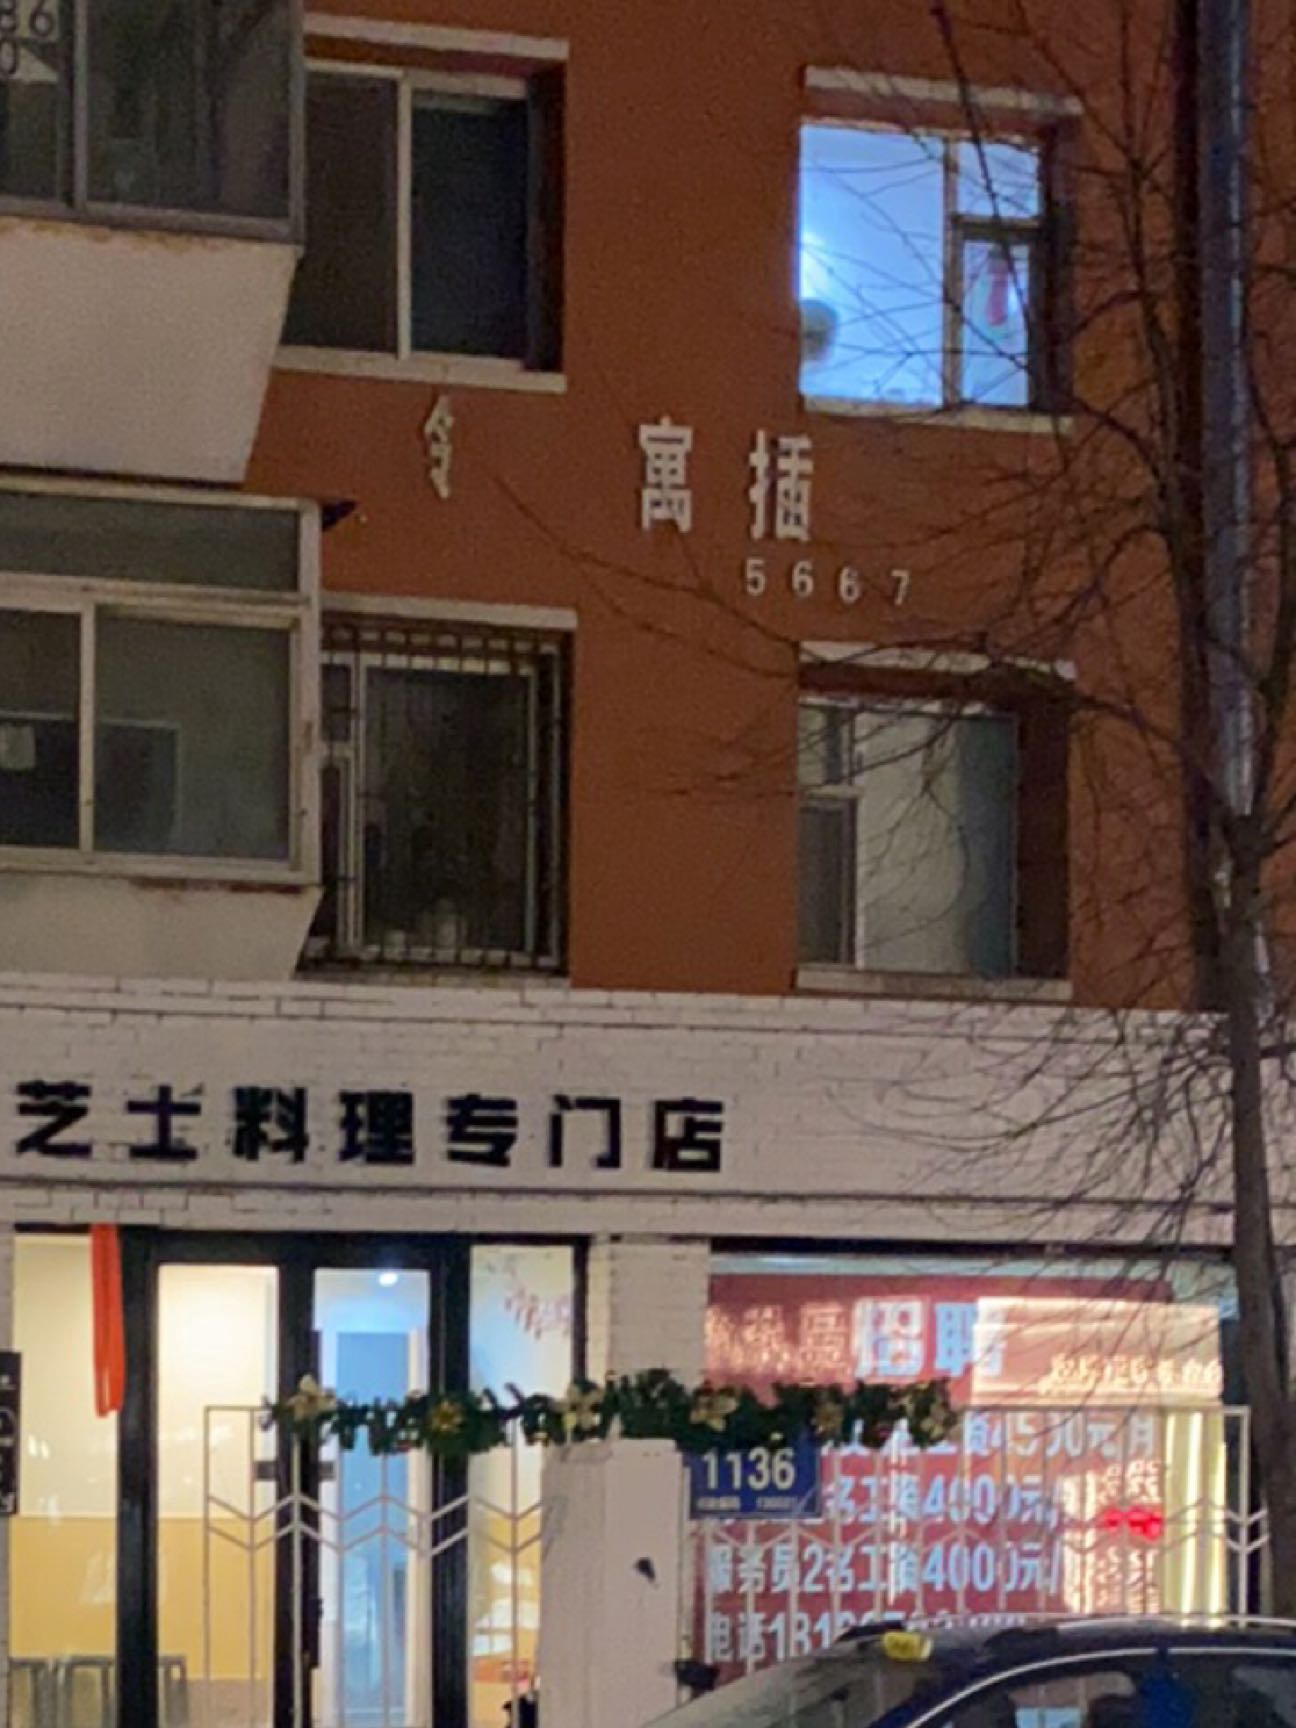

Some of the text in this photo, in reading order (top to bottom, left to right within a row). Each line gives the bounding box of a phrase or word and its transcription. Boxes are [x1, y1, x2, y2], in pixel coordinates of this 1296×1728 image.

[746, 558, 910, 606] 5667
[15, 1080, 725, 1173] 芝士料理专门店
[702, 1446, 796, 1491] 1136
